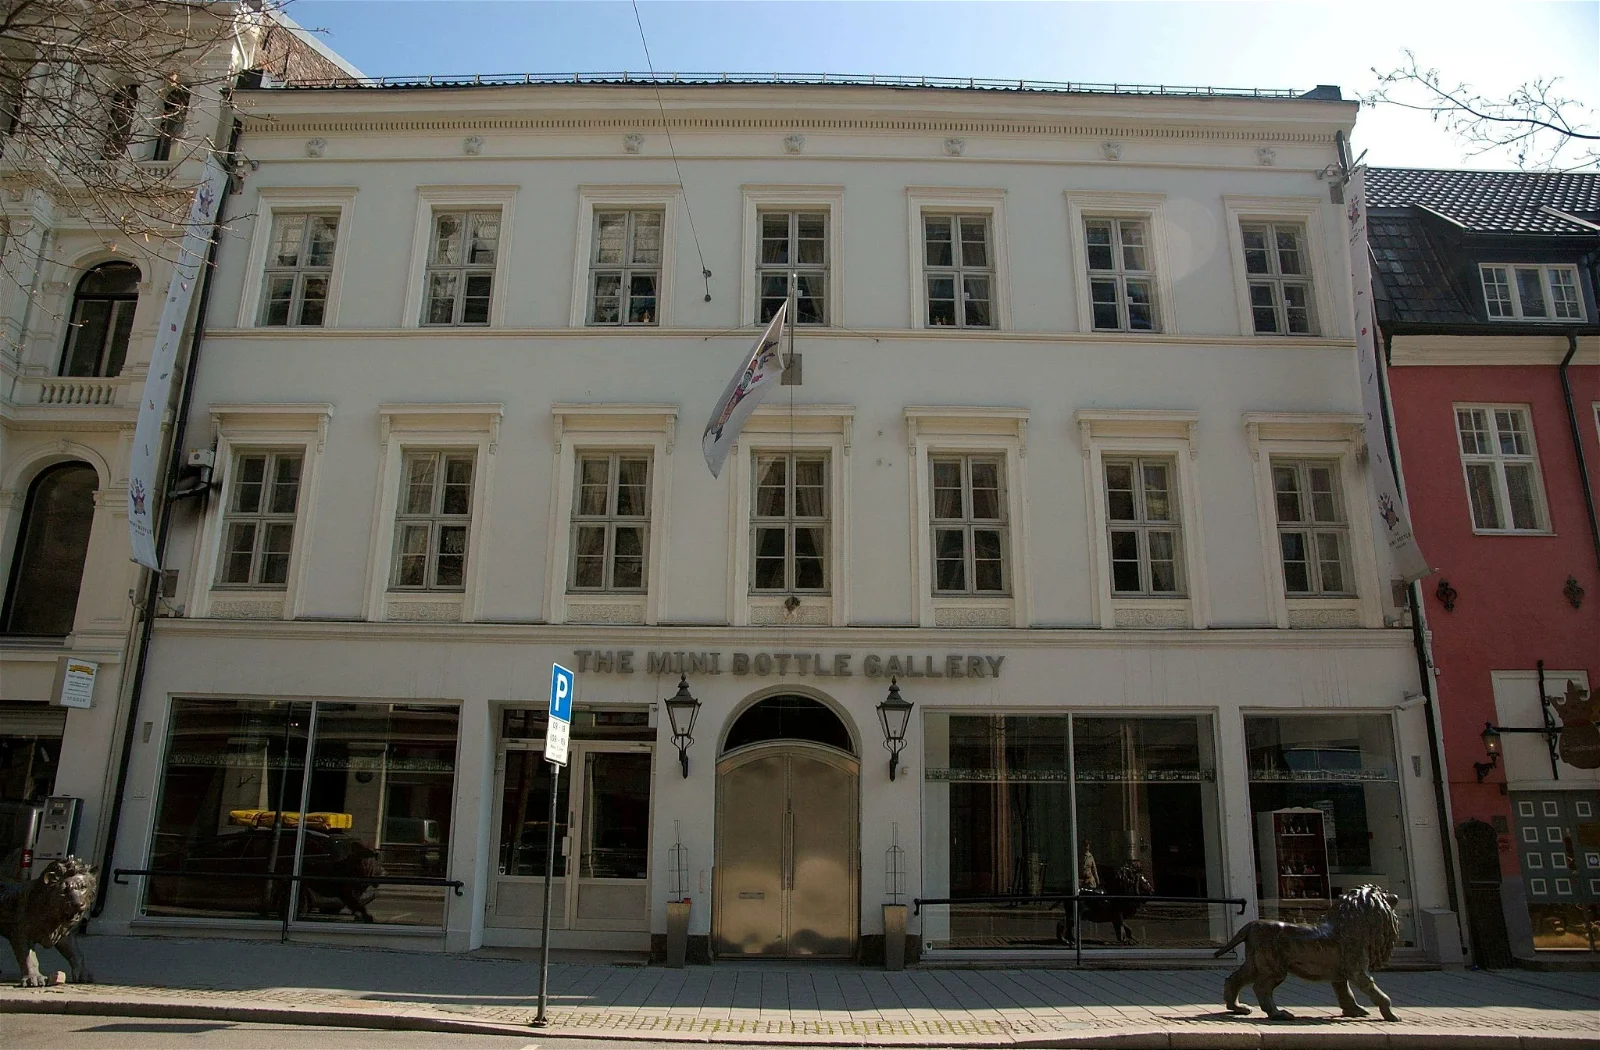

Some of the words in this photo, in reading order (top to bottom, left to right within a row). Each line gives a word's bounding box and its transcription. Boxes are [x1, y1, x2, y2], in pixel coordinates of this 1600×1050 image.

[574, 650, 634, 674] THE
[647, 651, 721, 675] MINI
[732, 652, 852, 677] BOTTLE
[863, 654, 1005, 678] GALLERY
[554, 672, 568, 712] P
